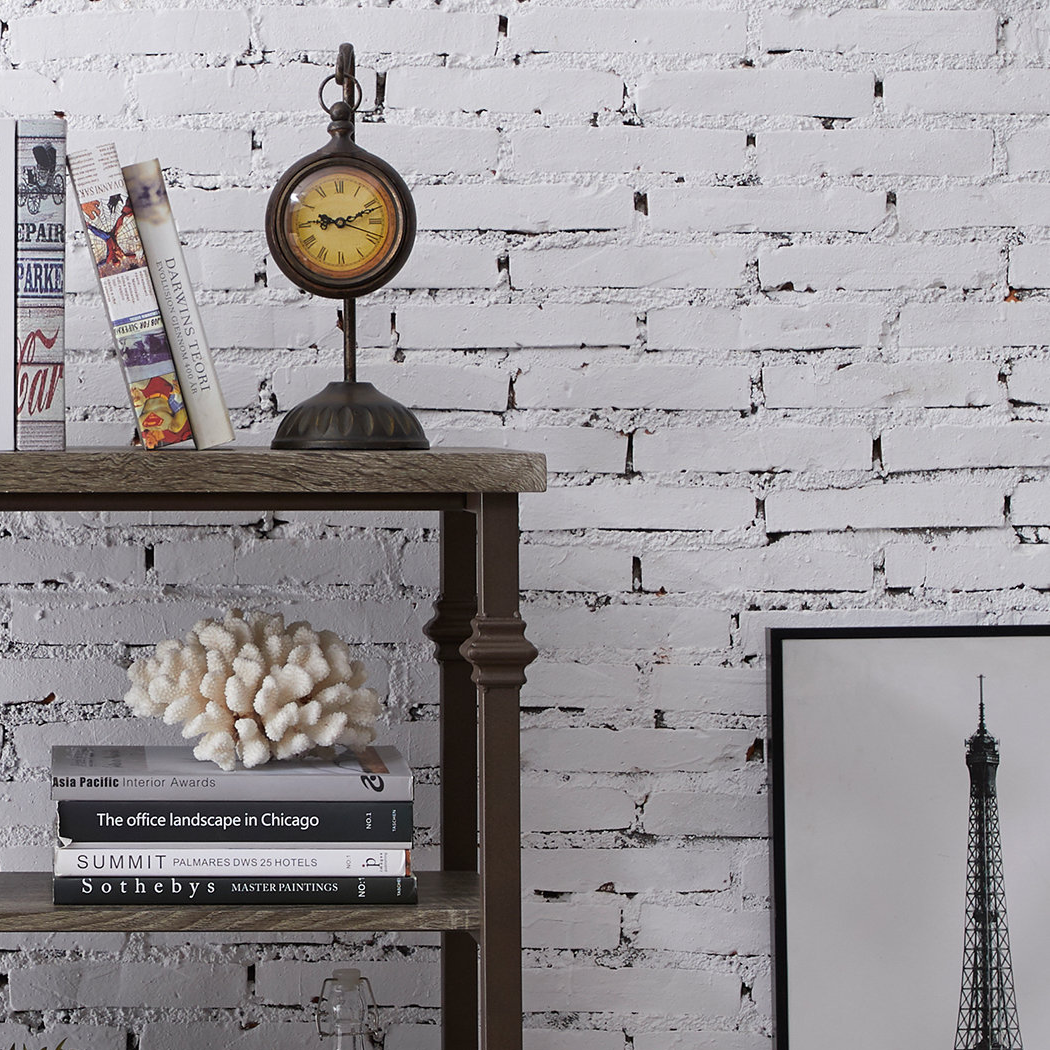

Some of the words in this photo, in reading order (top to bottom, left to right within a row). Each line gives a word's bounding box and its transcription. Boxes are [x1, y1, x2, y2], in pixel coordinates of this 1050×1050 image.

[164, 258, 196, 337] DARWINS
[189, 339, 211, 392] TEORI
[52, 776, 76, 788] Asia
[80, 776, 119, 788] Pacific
[122, 777, 166, 788] Interior
[170, 777, 216, 788] Awards
[97, 812, 123, 826] The
[126, 812, 166, 826] office
[170, 812, 241, 830] landscape
[244, 813, 257, 826] in
[262, 812, 320, 830] Chicago
[77, 854, 166, 870] SUMMIT
[172, 858, 230, 867] PALMARES
[233, 858, 258, 867] DWS
[260, 858, 272, 867] 25
[275, 858, 318, 867] HOTELS
[82, 878, 216, 898] Sothebys
[232, 882, 277, 892] MASTER
[278, 882, 338, 892] PAINTINGS
